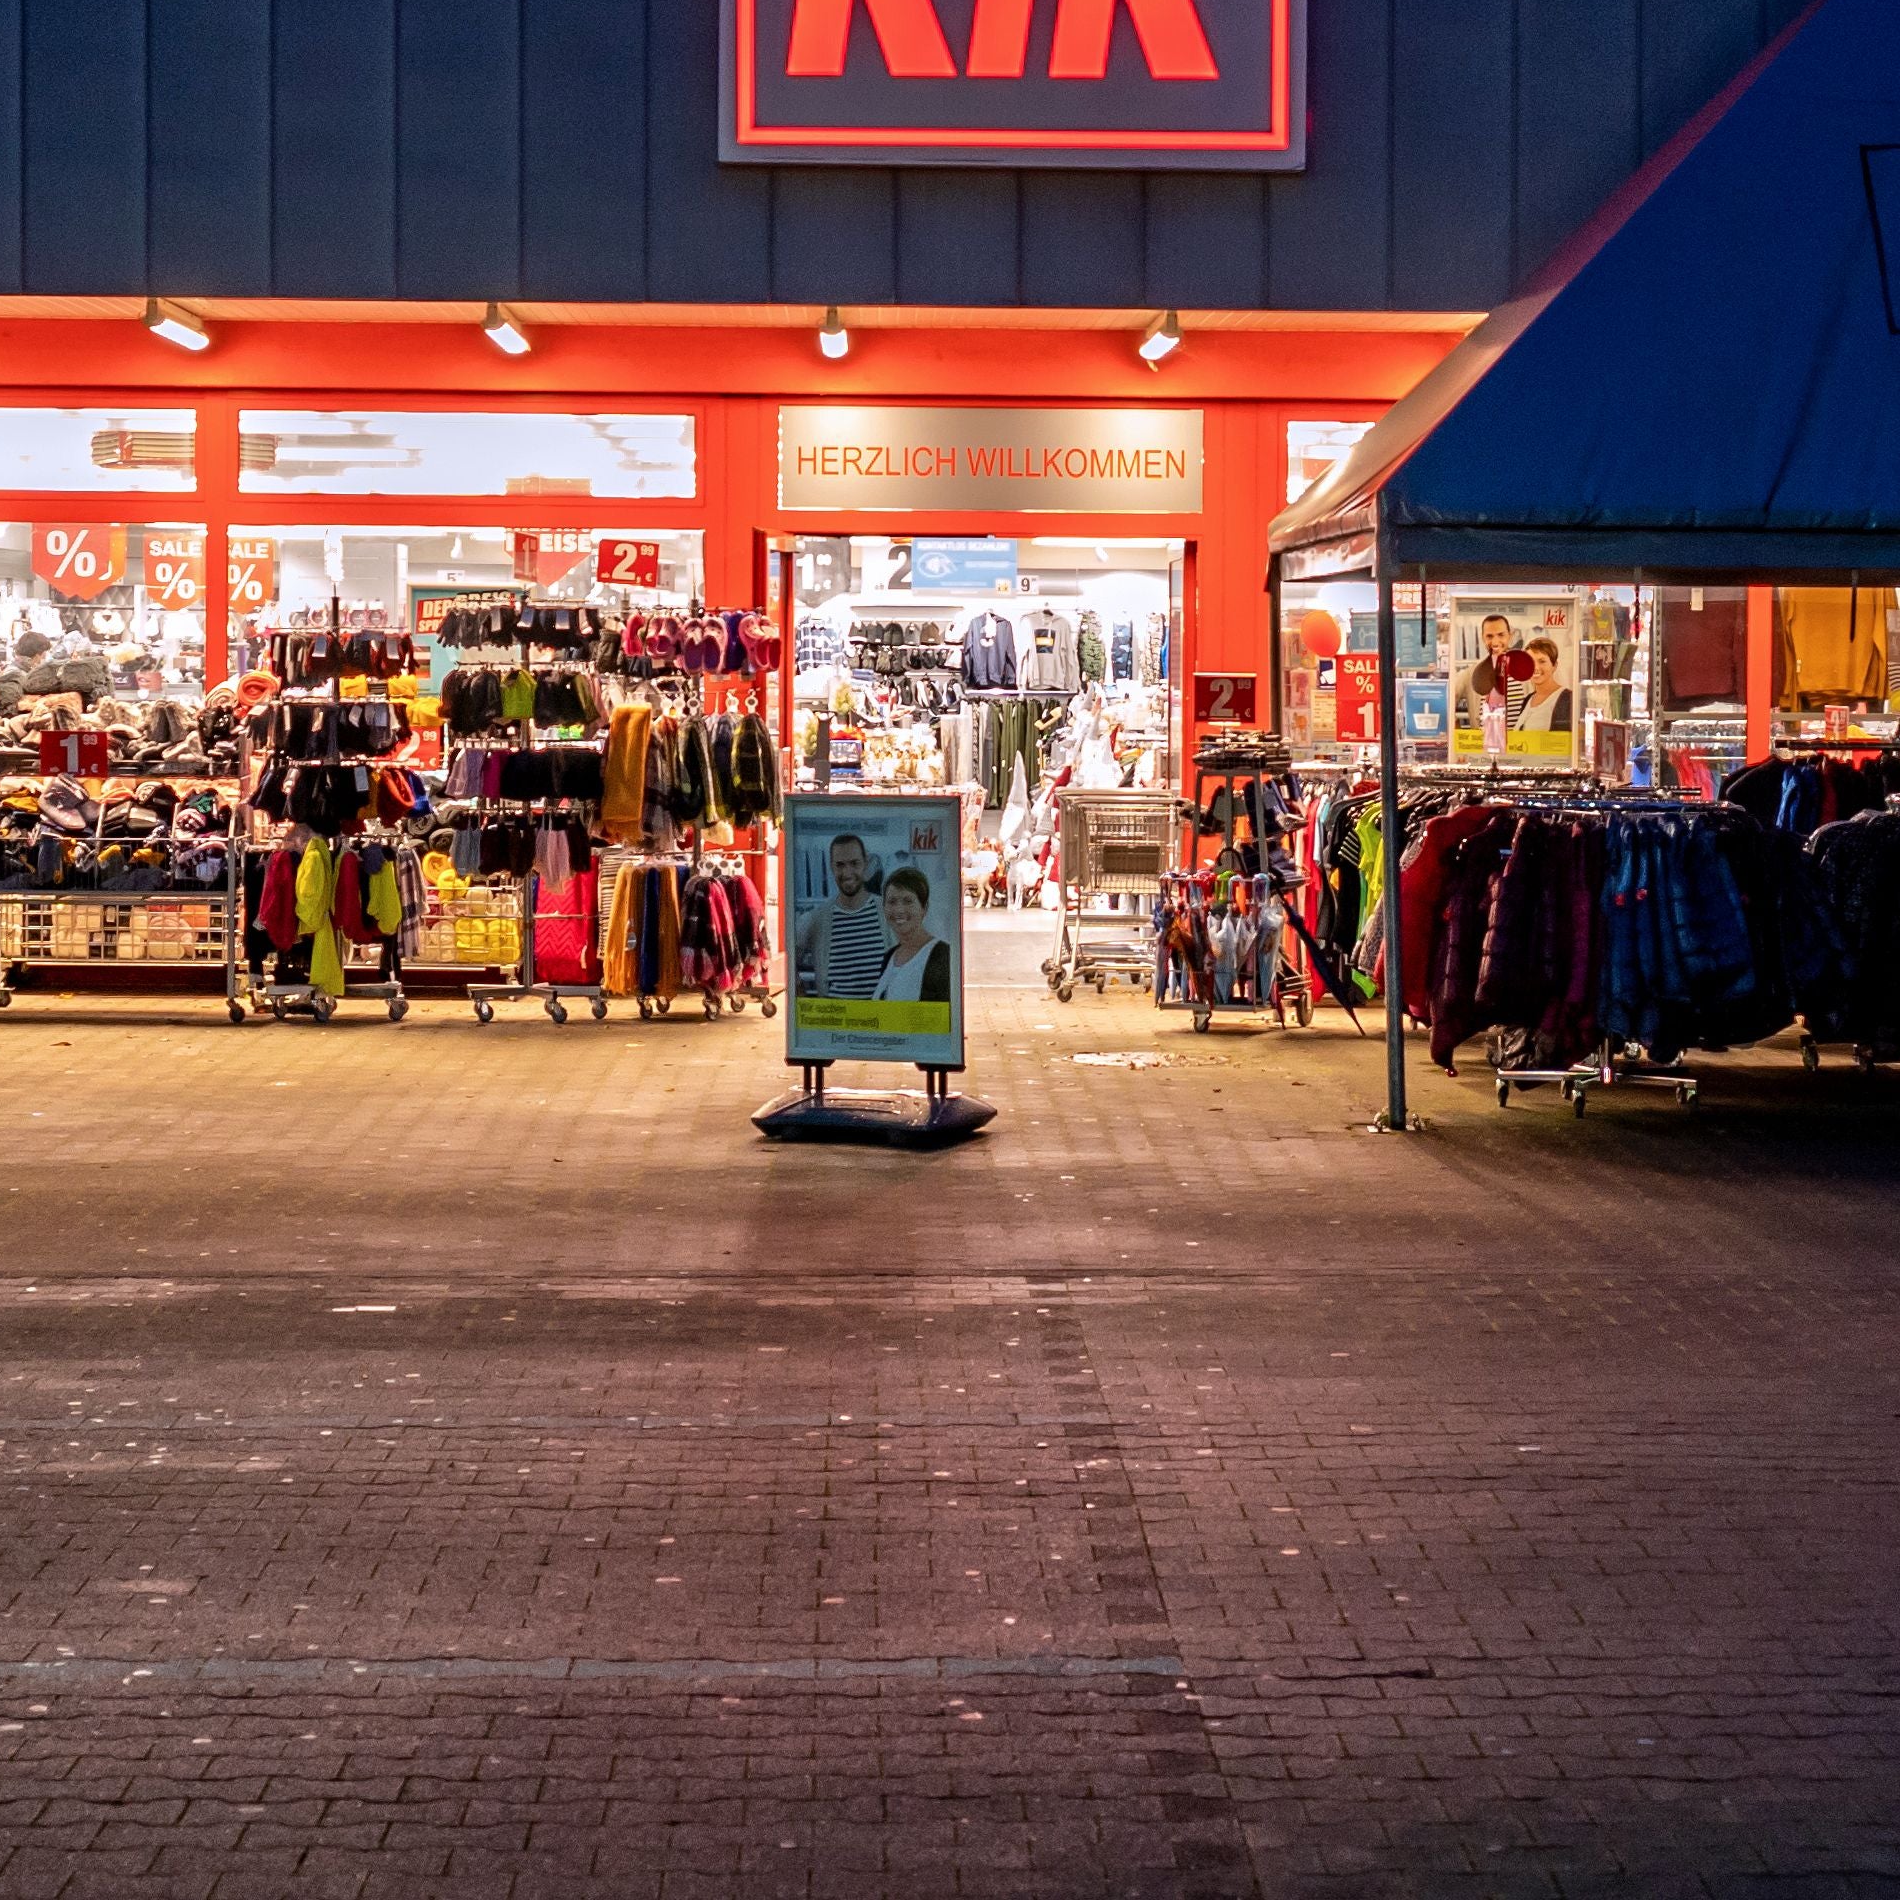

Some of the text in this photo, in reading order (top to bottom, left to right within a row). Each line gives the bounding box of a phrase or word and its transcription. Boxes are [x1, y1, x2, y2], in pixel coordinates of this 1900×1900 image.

[797, 445, 1186, 479] HERZLICH WILLKOMMEN
[149, 540, 202, 557] SALE
[1546, 606, 1566, 626] kik
[912, 823, 939, 850] kik
